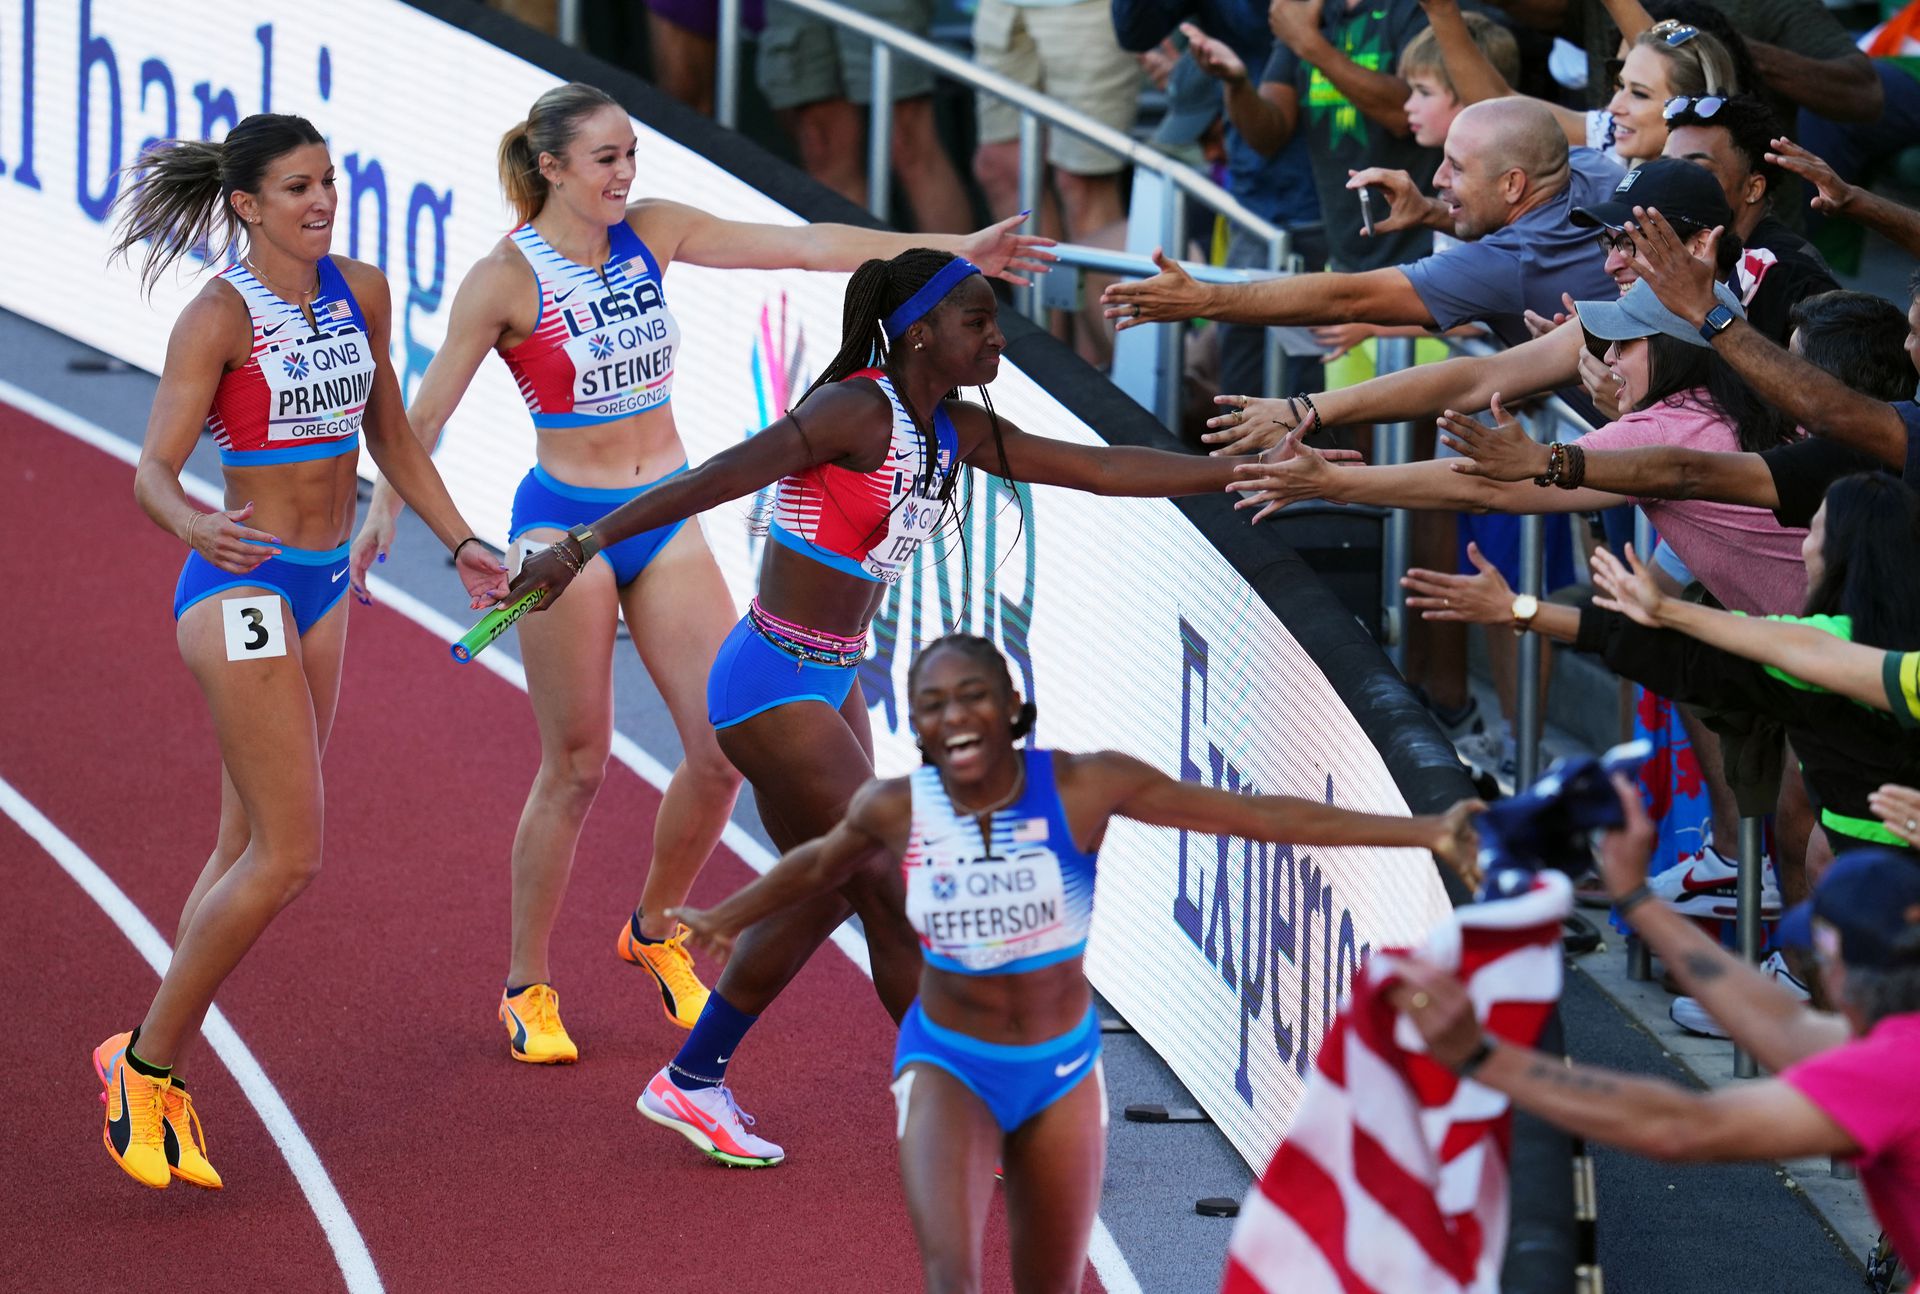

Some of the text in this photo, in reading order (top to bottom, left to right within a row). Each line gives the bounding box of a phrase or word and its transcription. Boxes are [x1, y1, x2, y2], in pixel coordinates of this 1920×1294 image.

[563, 282, 666, 337] USA
[618, 318, 667, 350] QNB
[312, 342, 361, 371] QNB
[582, 345, 673, 396] STEINER
[596, 385, 668, 414] OREGON22
[240, 607, 269, 650] 3
[966, 868, 1037, 897] QNB
[923, 900, 1057, 940] JEFFERSON
